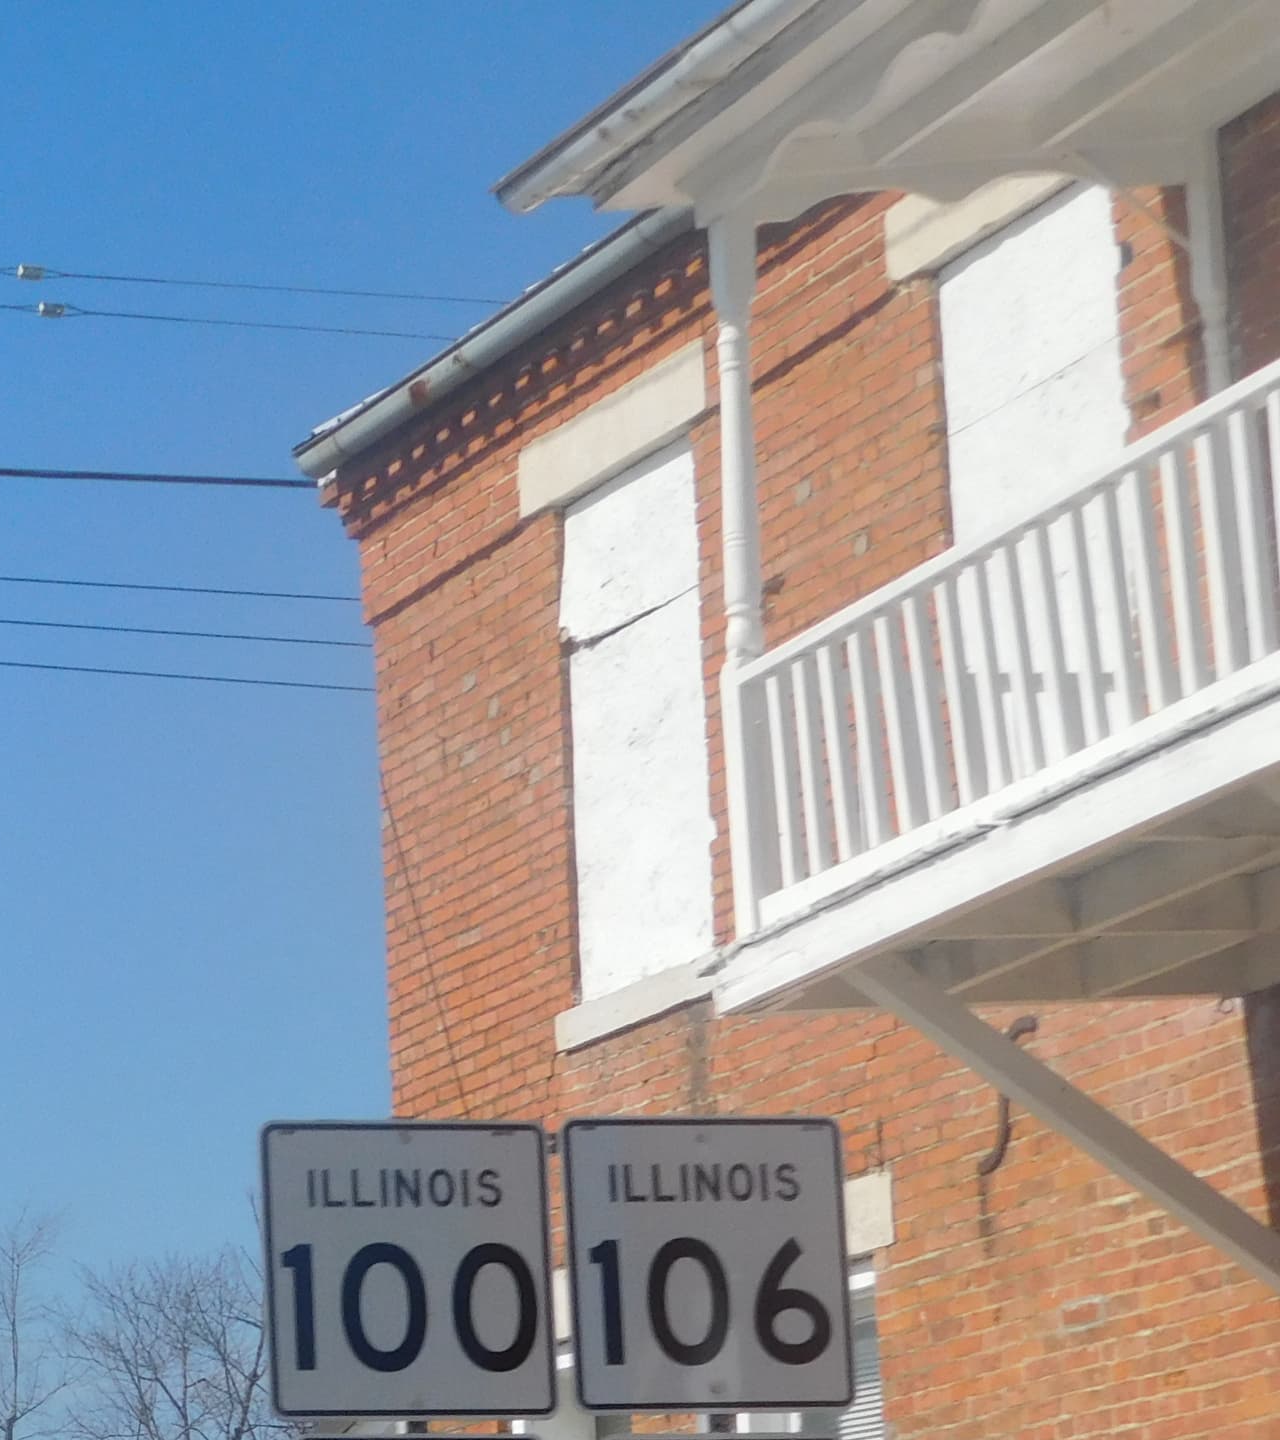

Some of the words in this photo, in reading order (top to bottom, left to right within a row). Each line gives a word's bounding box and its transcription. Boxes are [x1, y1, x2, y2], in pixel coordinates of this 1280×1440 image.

[307, 1169, 503, 1208] ILLINOIS
[608, 1163, 800, 1202] ILLINOIS
[281, 1242, 538, 1373] 100
[589, 1236, 831, 1366] 106
